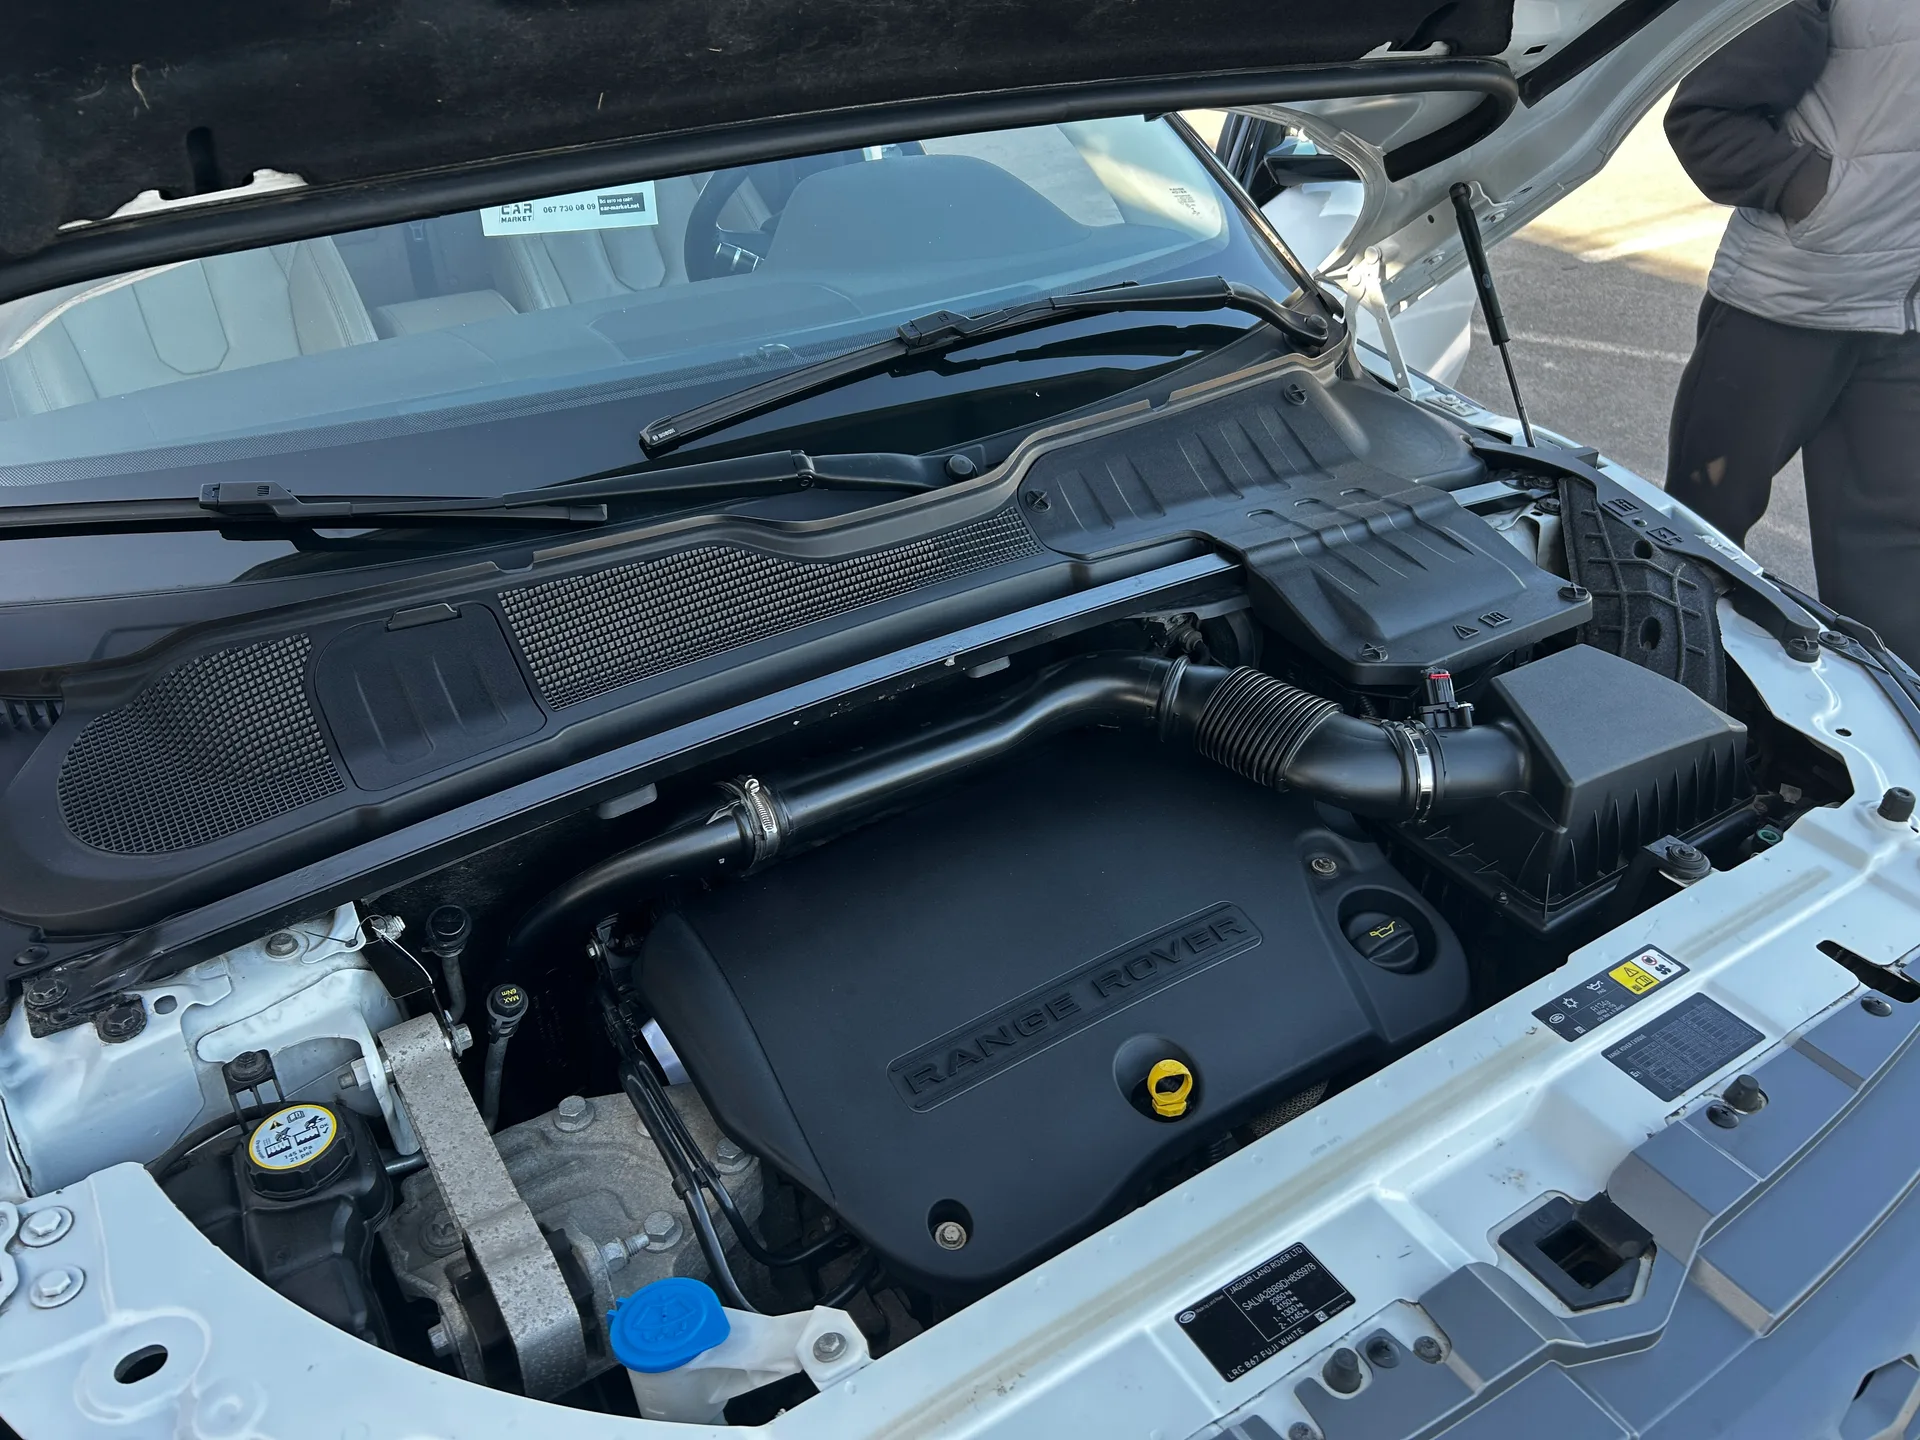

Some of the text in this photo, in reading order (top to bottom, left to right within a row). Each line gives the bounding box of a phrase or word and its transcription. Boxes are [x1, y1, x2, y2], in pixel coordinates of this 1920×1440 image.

[501, 202, 532, 215] CAR
[600, 203, 640, 211] car-market.net
[501, 215, 532, 223] MARKET
[501, 988, 517, 996] 6Nm
[503, 994, 520, 1004] MAX
[903, 915, 1247, 1095] RANGE ROVER
[284, 1145, 313, 1160] 145 kPa
[289, 1151, 312, 1163] 21 psi
[1228, 1246, 1303, 1294] JAGUAR LAND ROVER LTD
[1269, 1292, 1287, 1306] 2350
[1276, 1298, 1292, 1311] 4150
[1280, 1304, 1298, 1318] 1300
[1286, 1312, 1304, 1324] 1145
[1226, 1327, 1305, 1380] LRC 867 FUJI WHITE
